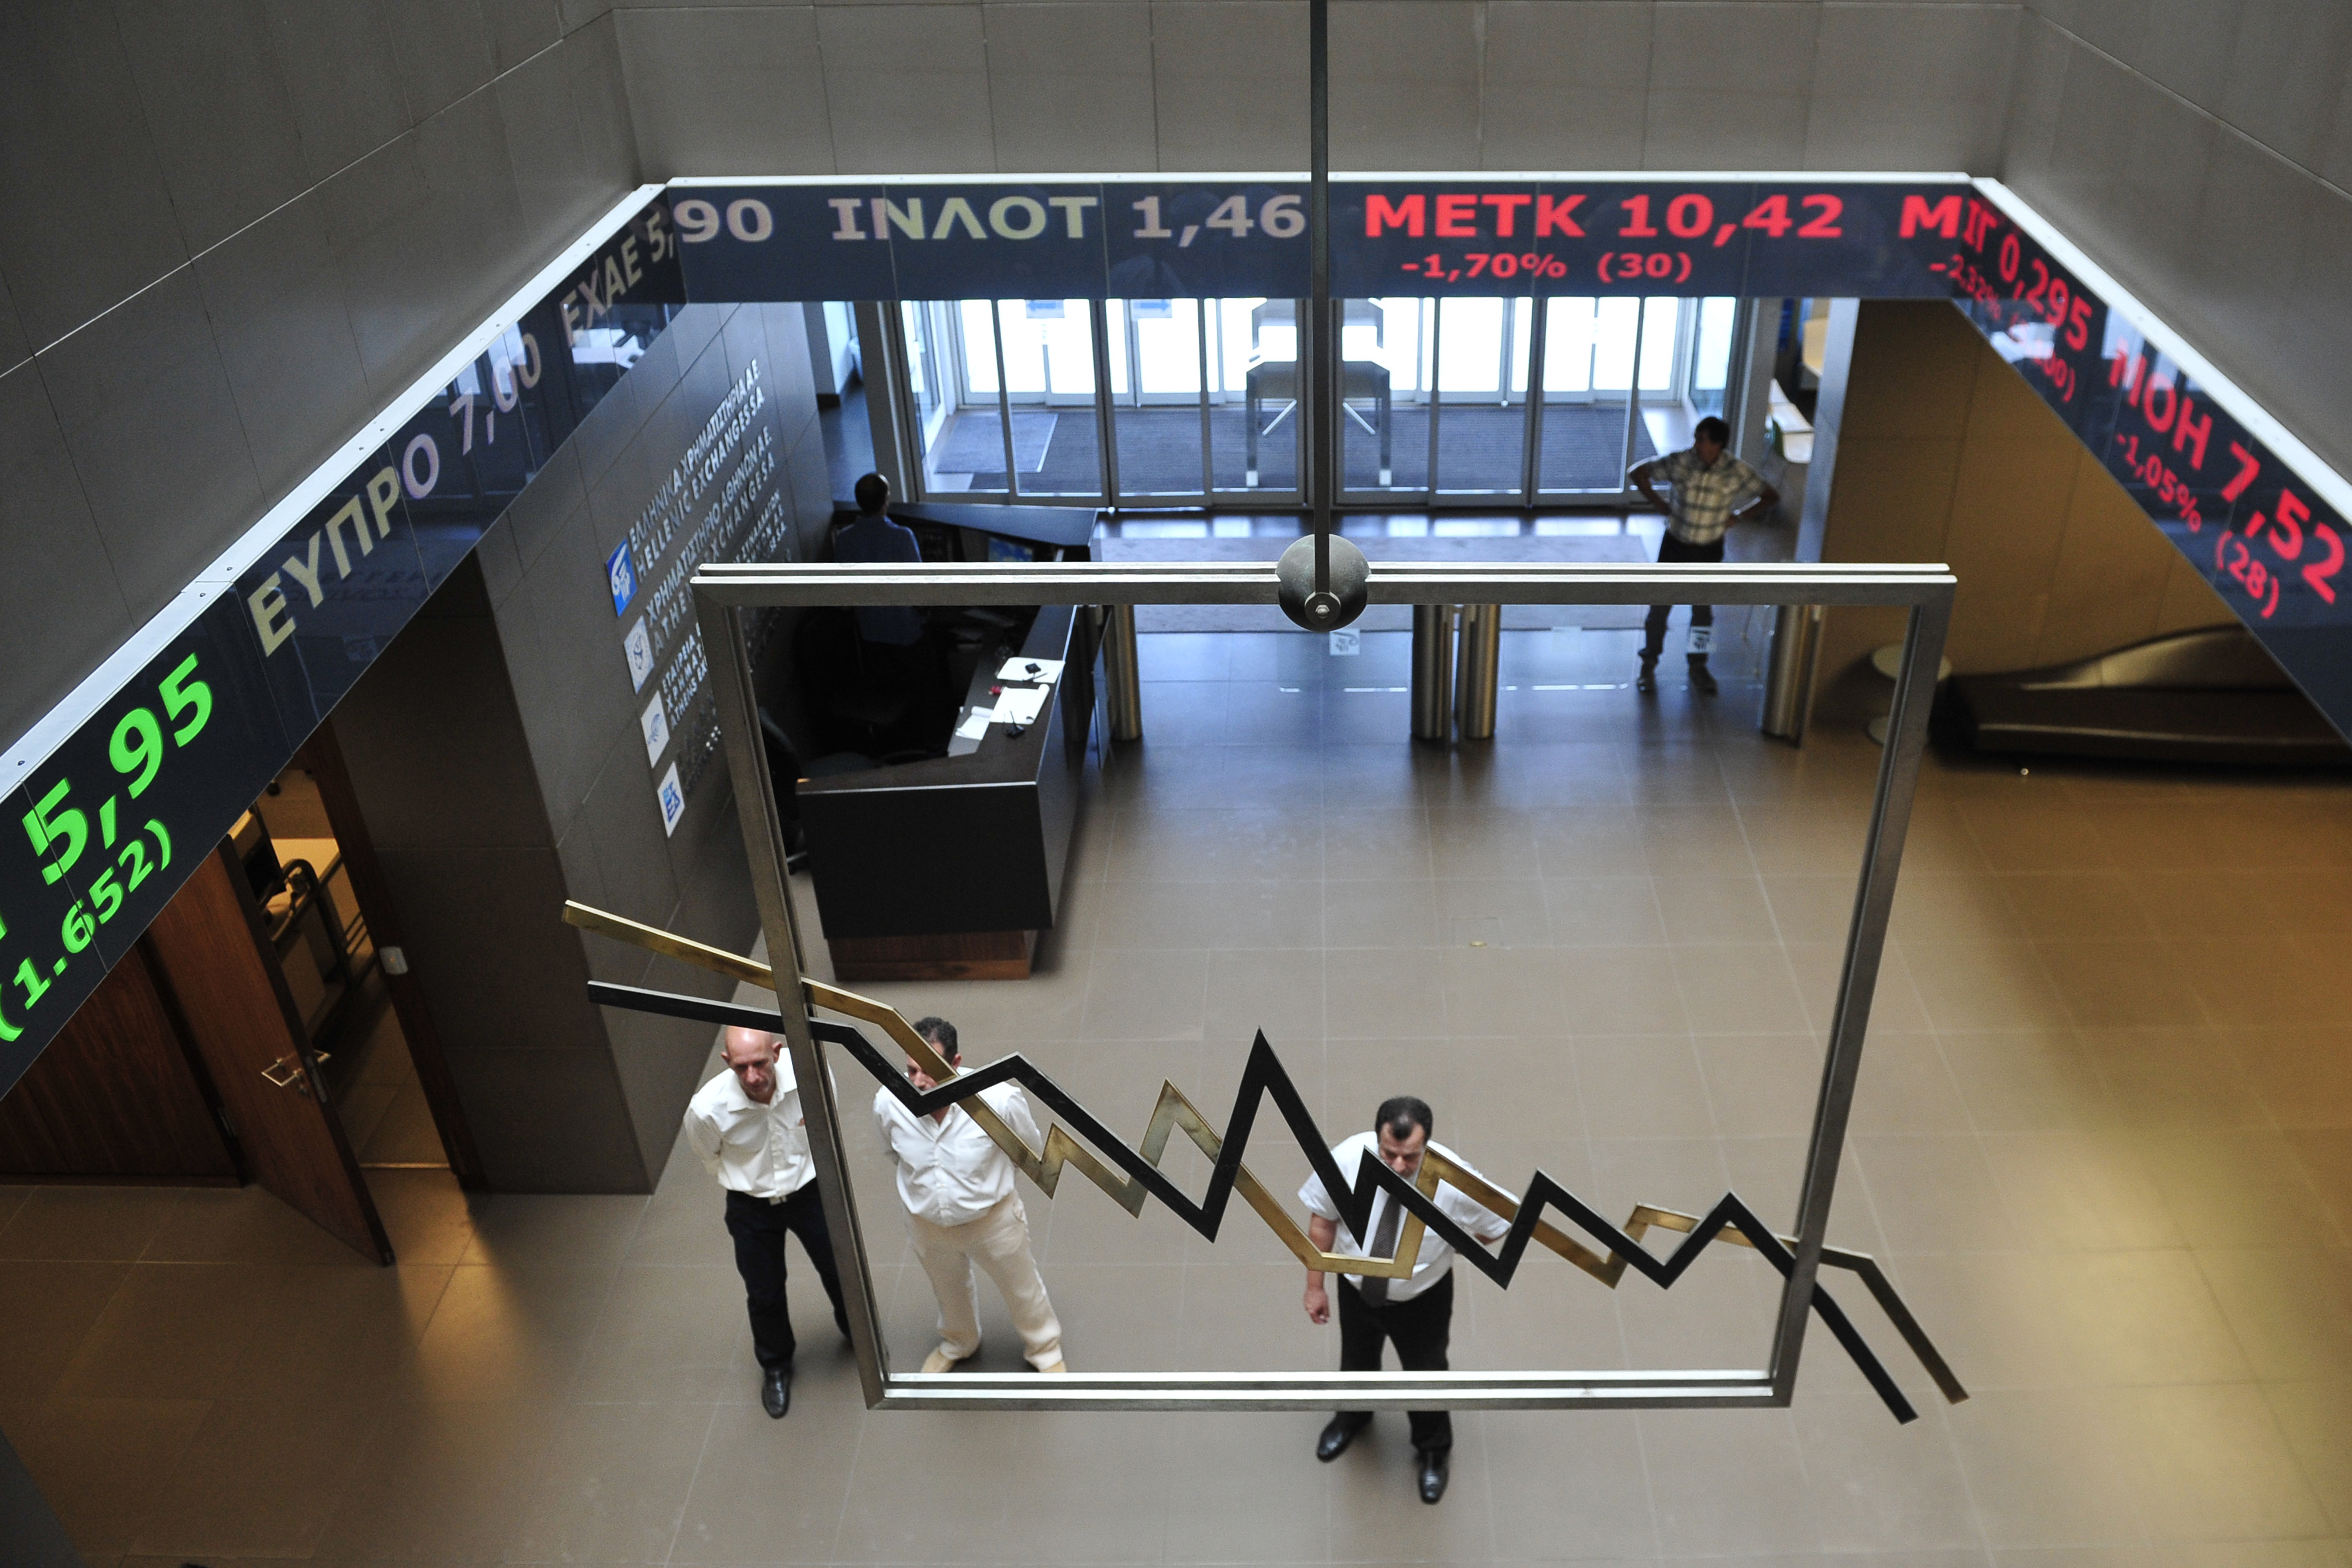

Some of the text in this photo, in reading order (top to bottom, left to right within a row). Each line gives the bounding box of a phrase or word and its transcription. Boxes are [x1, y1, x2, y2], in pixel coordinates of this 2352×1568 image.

[828, 194, 1306, 248] ΙΝΛΟΤ 1,46
[1365, 193, 1844, 248] ΜΕΤΚ 10,42
[1401, 252, 1692, 283] -1,70% (30)
[1999, 233, 2092, 351] 0,295
[248, 333, 541, 657] ΕΥΠΡΟ 7,00
[629, 469, 682, 552] ΕΛΛΗΝΙΚΑ
[680, 378, 747, 481] ΧΡΗΜΑΤΙΣΤΗΡΙΑ
[636, 489, 691, 583] HELLENIC
[692, 404, 750, 500] EXCHANGES
[646, 503, 720, 627] ΧΡΗΜΑΤΙΣΤΗΡΙΟ
[721, 444, 757, 513] ΑΘΗΝΩΝ
[2116, 433, 2280, 618] -1,05% (28)
[2221, 441, 2346, 605] 7,52
[22, 653, 212, 886] 5,95
[670, 677, 697, 730] ATHENS
